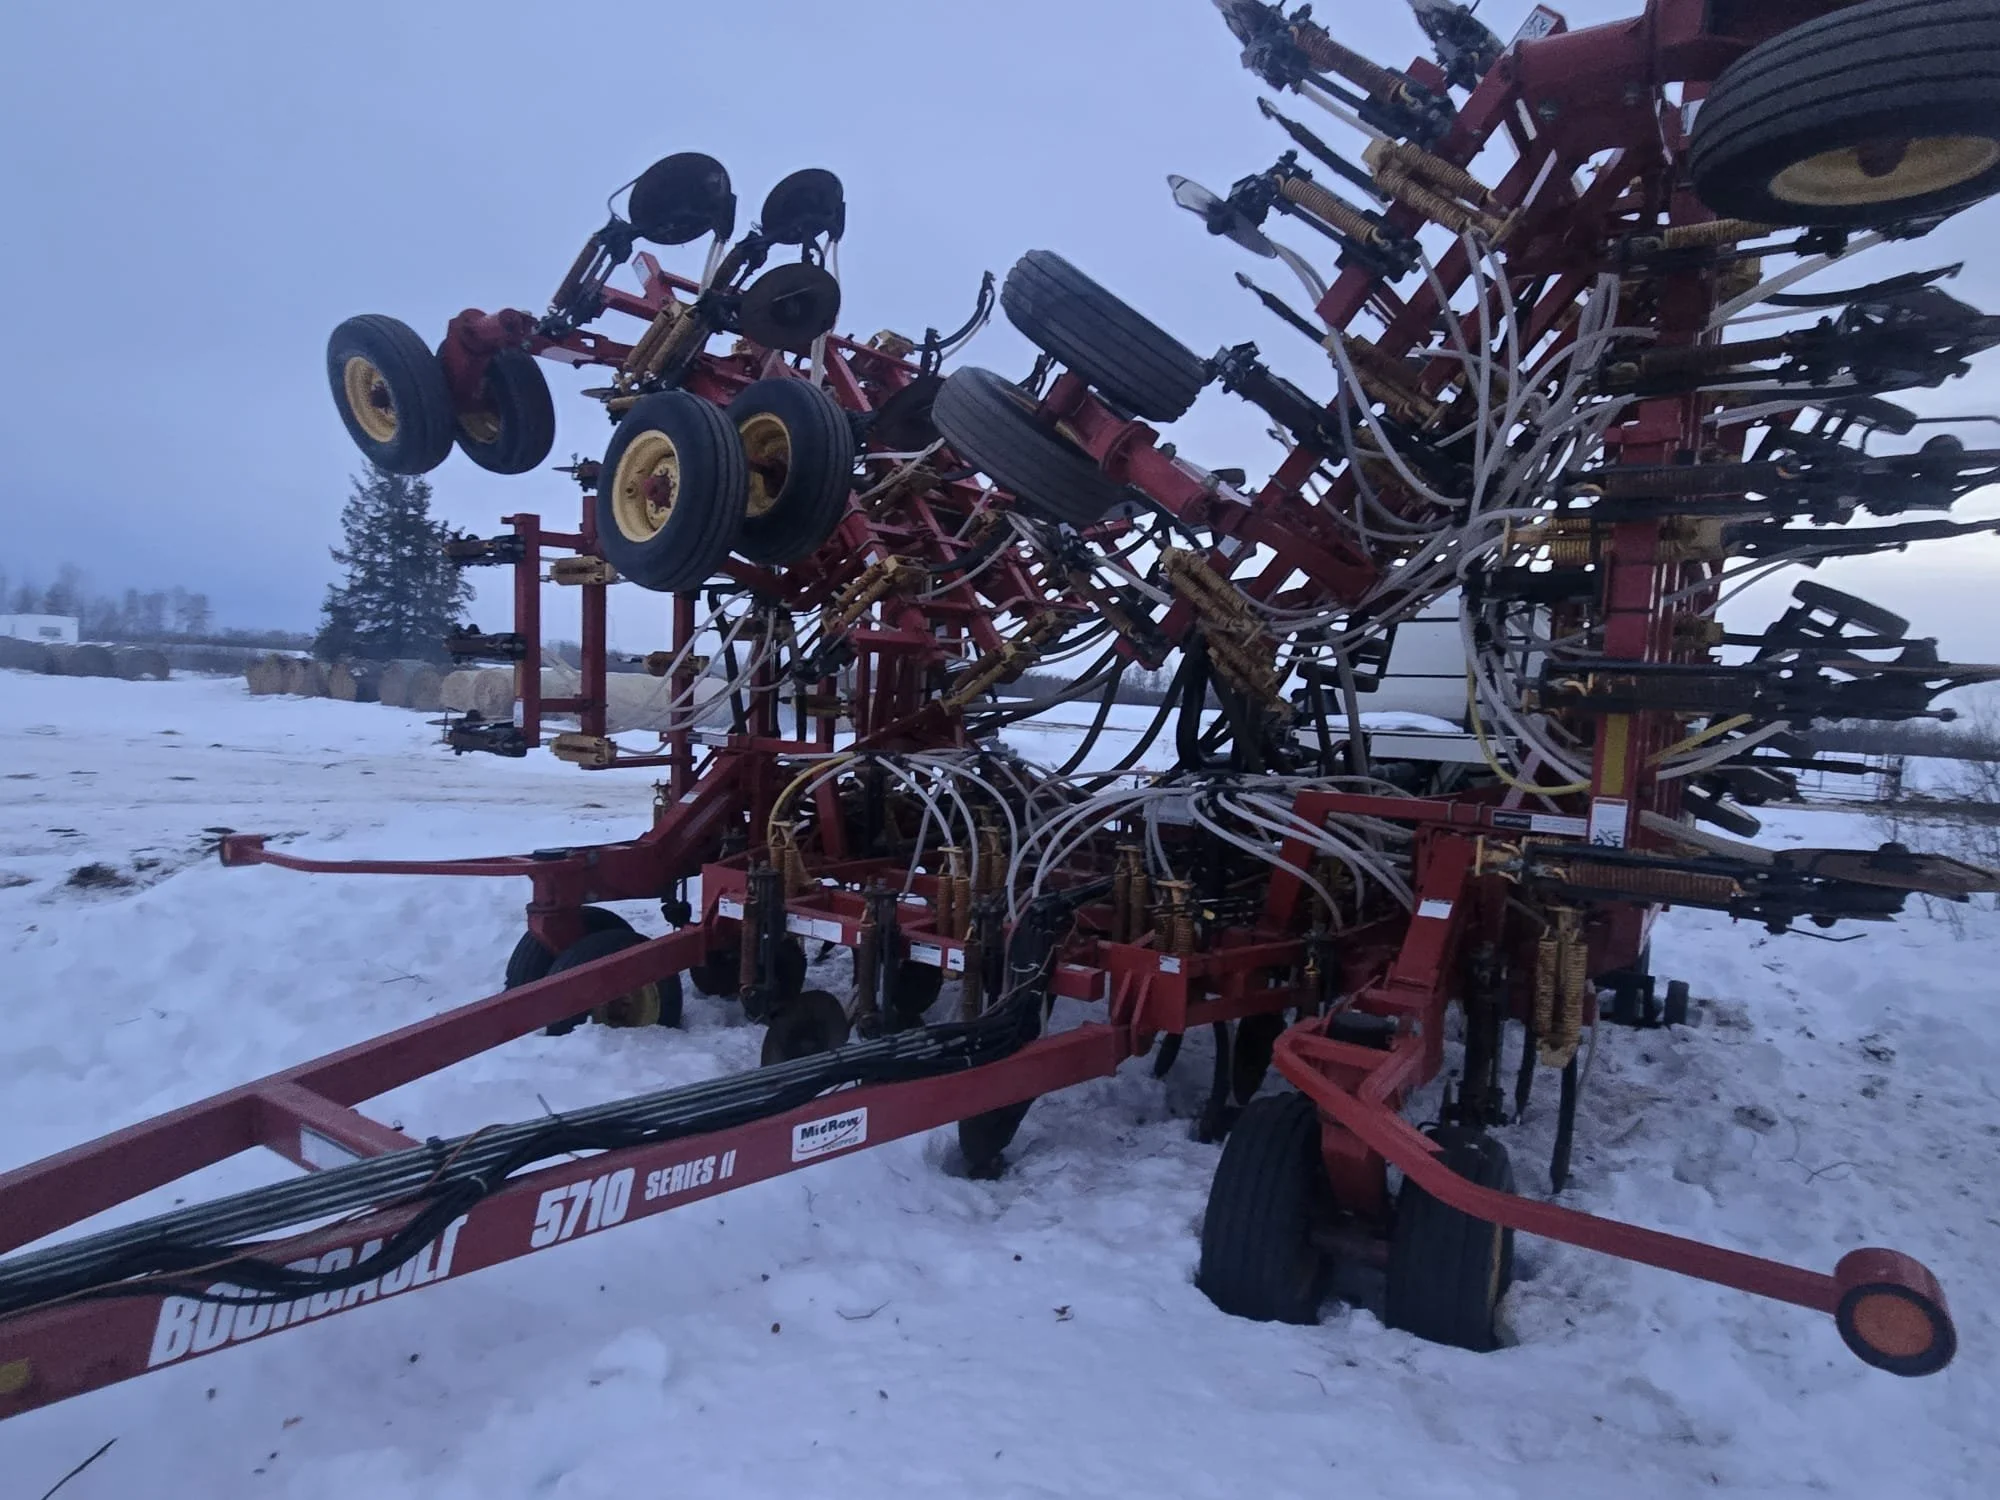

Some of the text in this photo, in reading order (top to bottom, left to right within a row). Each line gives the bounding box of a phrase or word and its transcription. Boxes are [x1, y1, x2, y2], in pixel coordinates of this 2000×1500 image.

[801, 1116, 860, 1140] MidRow
[530, 1150, 737, 1248] 5710 SERIES II
